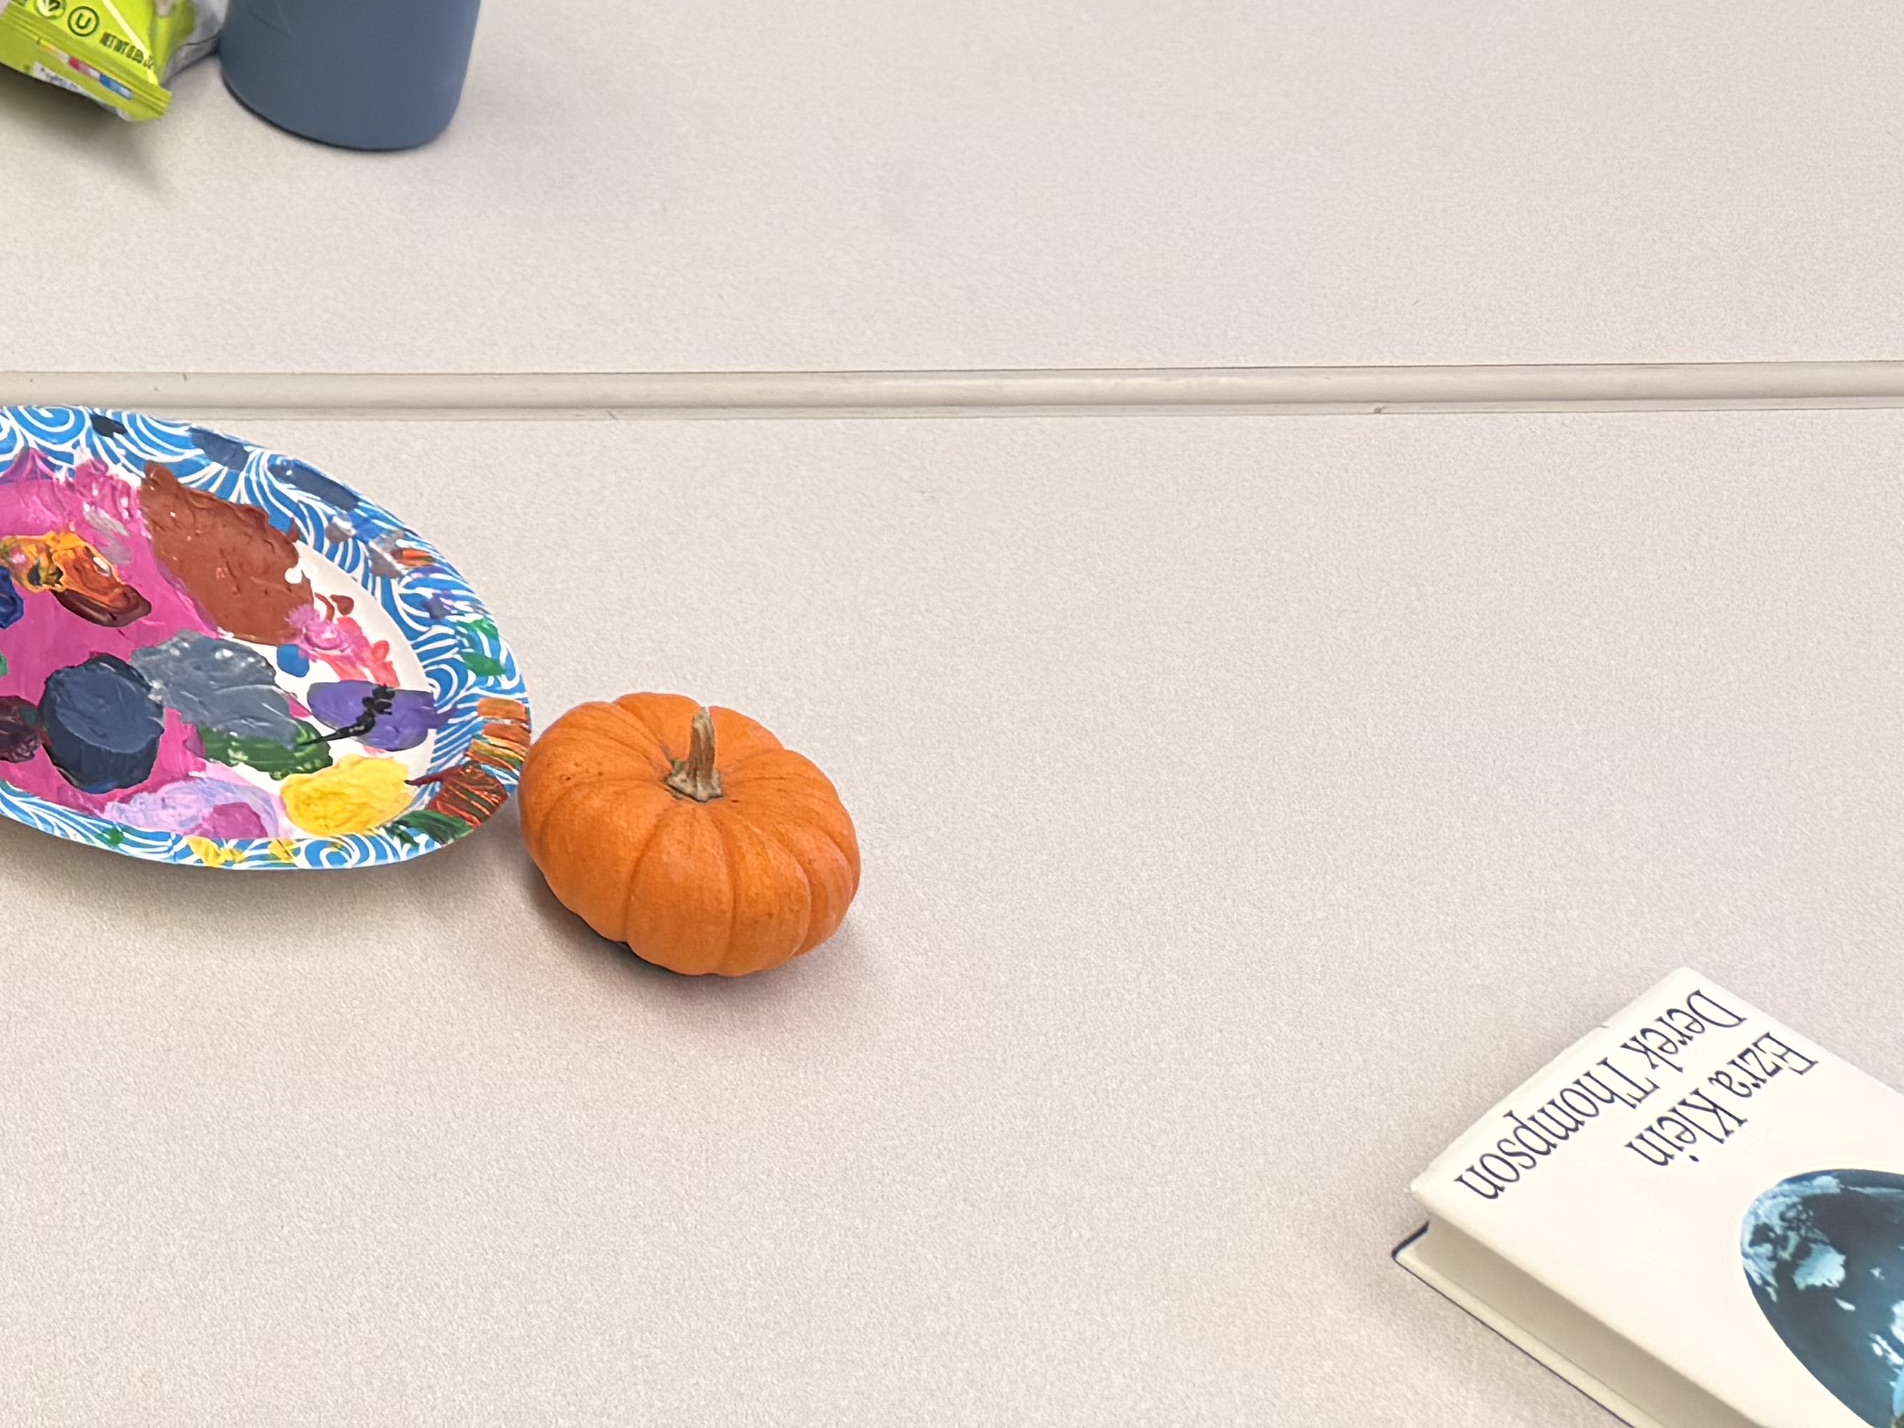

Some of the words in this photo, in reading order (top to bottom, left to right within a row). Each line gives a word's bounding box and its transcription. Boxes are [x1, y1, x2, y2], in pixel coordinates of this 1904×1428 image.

[1619, 989, 1748, 1074] Derek
[1707, 1031, 1819, 1101] Ezra
[1453, 1056, 1660, 1201] Thompson
[1622, 1087, 1748, 1168] Klein
